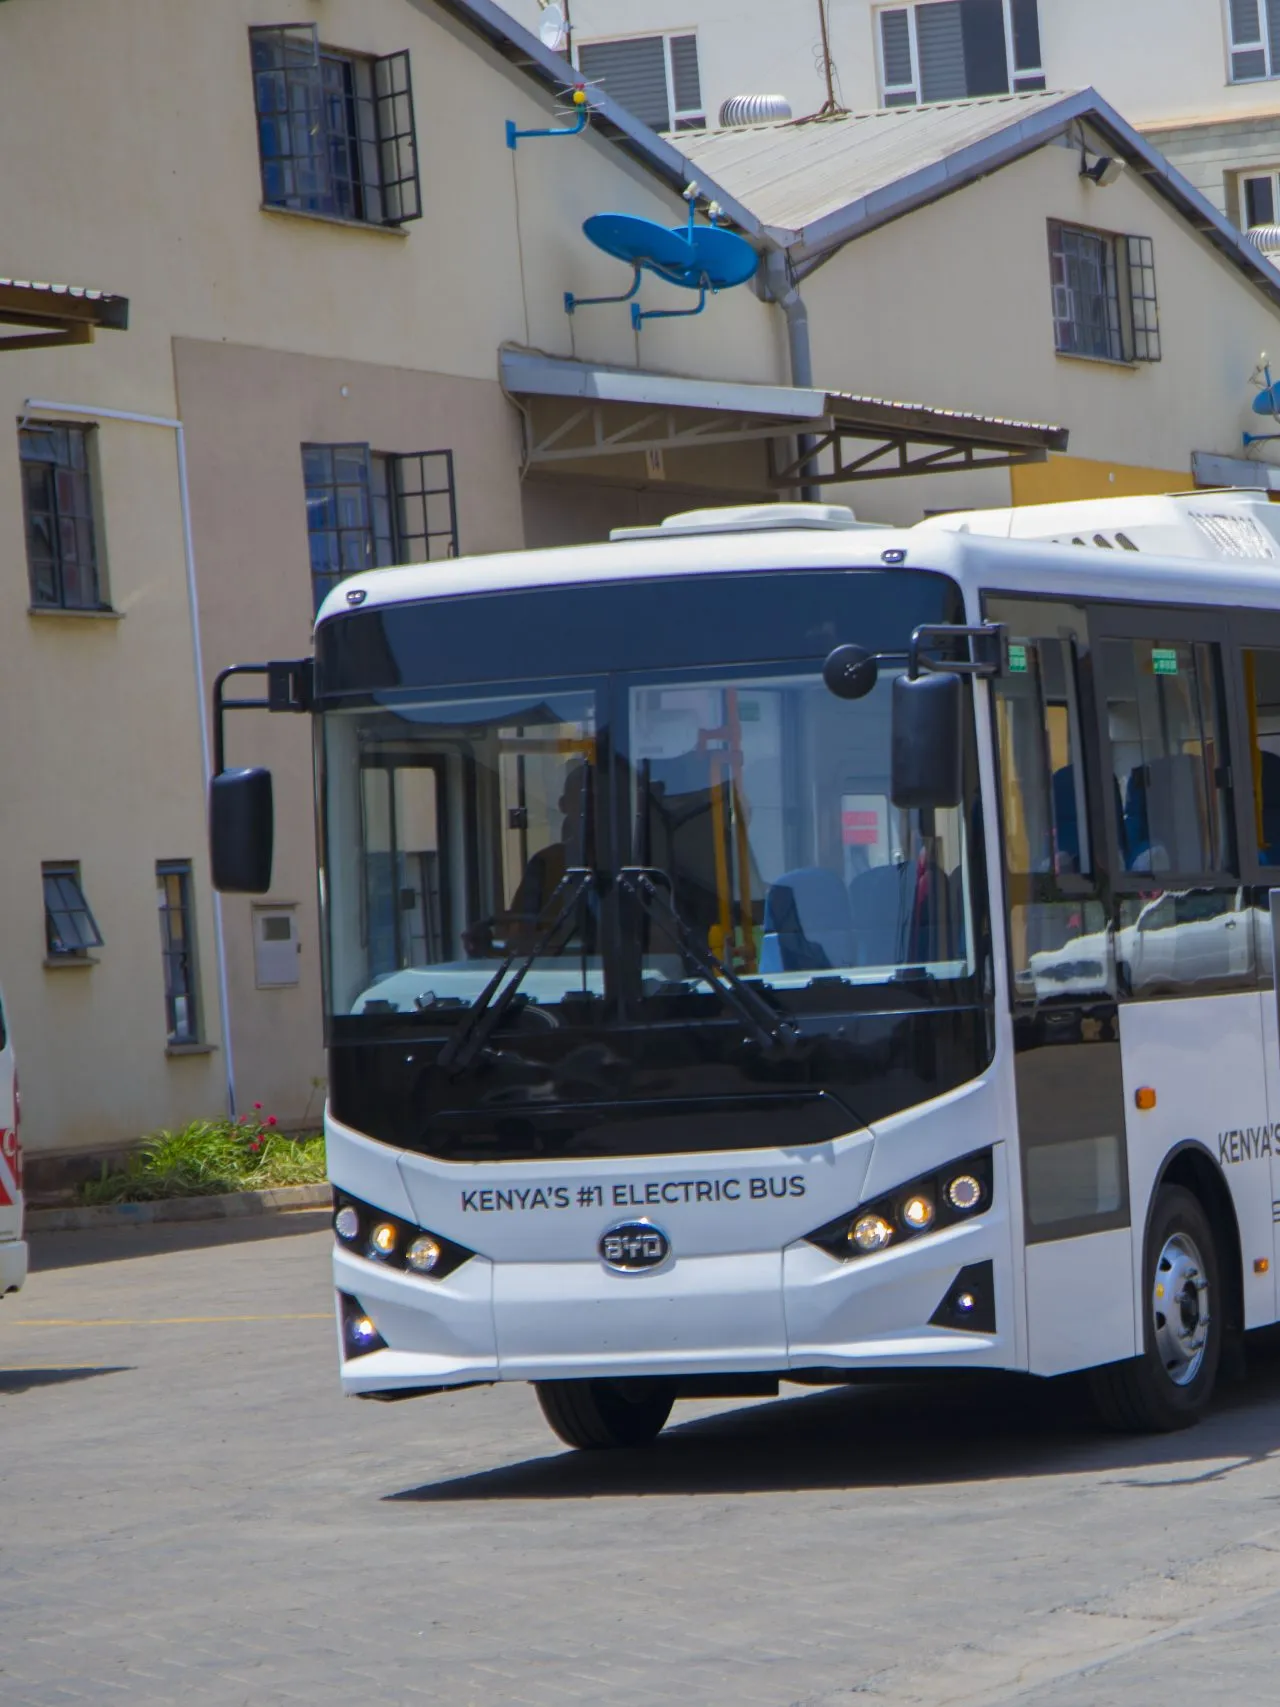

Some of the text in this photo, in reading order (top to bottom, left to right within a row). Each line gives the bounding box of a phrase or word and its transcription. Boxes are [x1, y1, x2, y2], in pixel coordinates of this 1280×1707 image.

[460, 1175, 806, 1213] KENYA'S #1 ELECTRIC BUS
[604, 1233, 662, 1260] BYD
